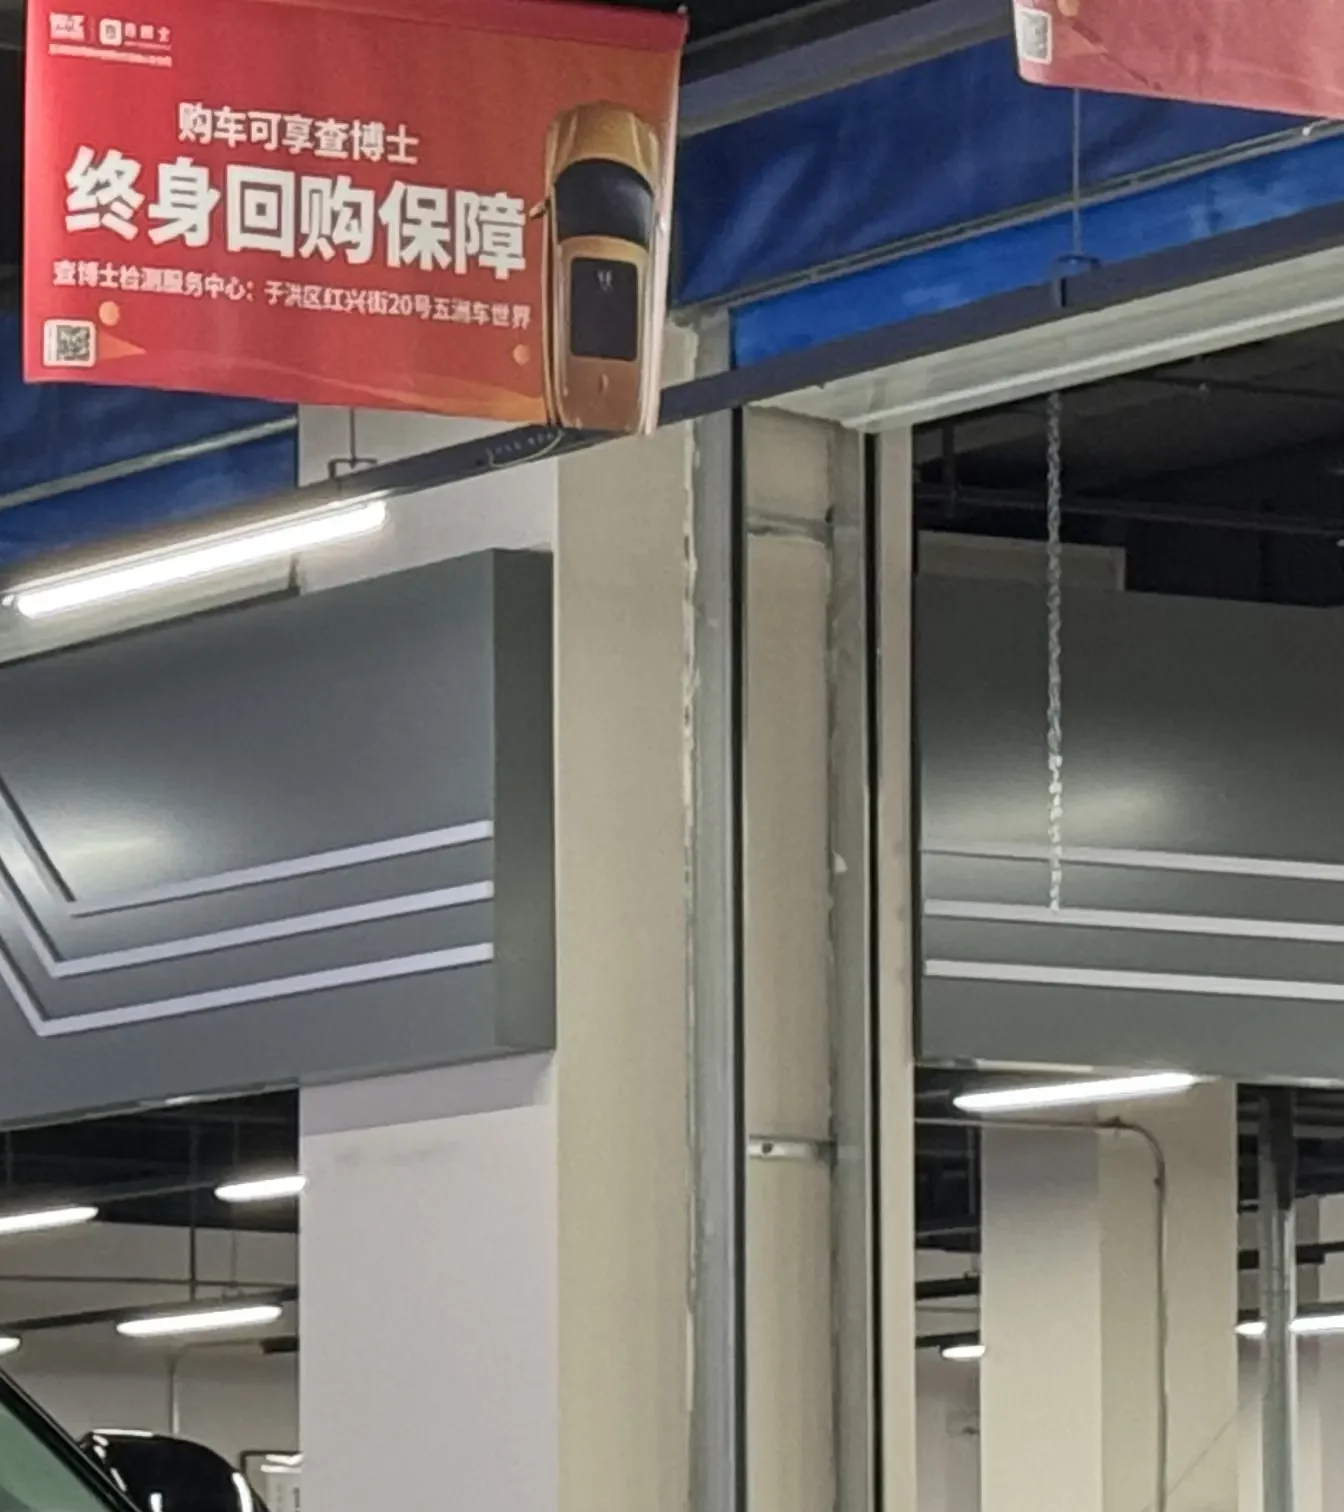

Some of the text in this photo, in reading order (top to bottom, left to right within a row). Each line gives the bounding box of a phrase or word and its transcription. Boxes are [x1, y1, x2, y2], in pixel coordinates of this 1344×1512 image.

[178, 102, 419, 164] 购车可享查博士
[64, 146, 526, 279] 终身回购保障
